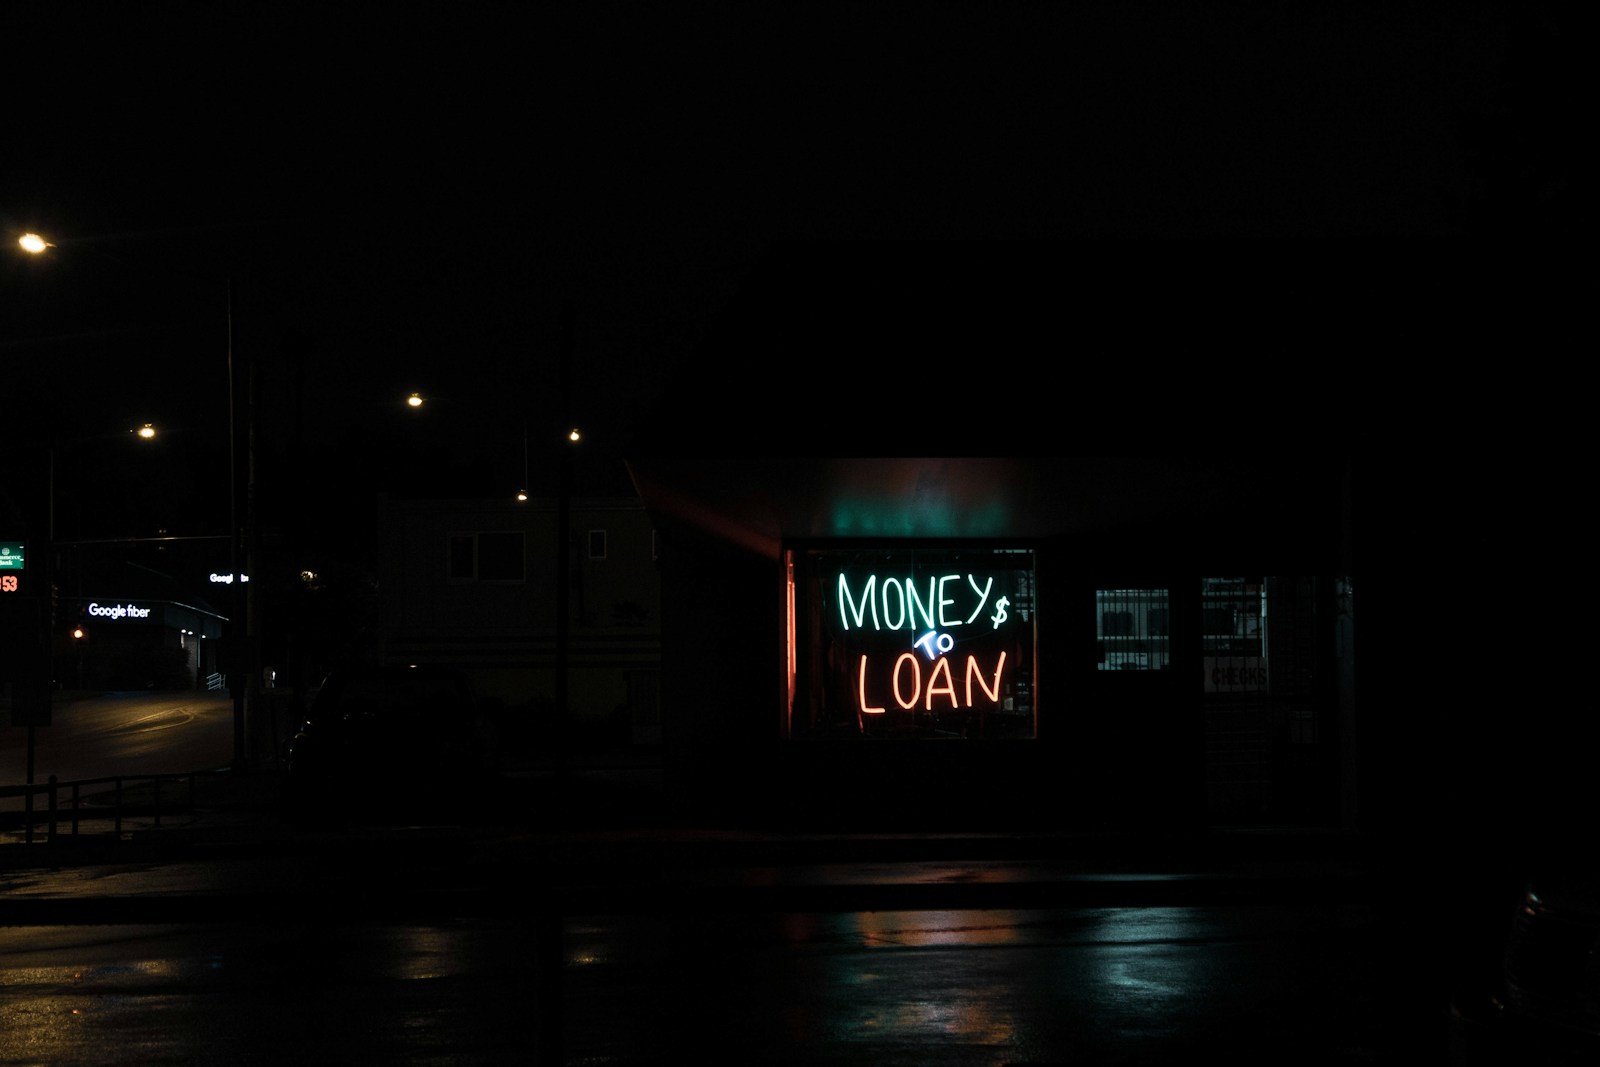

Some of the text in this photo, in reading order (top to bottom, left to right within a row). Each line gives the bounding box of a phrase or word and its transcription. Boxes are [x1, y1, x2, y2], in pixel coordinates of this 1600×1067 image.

[0, 576, 17, 592] 53
[209, 573, 233, 584] Googl
[838, 572, 992, 631] MONEY
[88, 602, 151, 619] Google fiber
[859, 651, 1006, 713] LOAN
